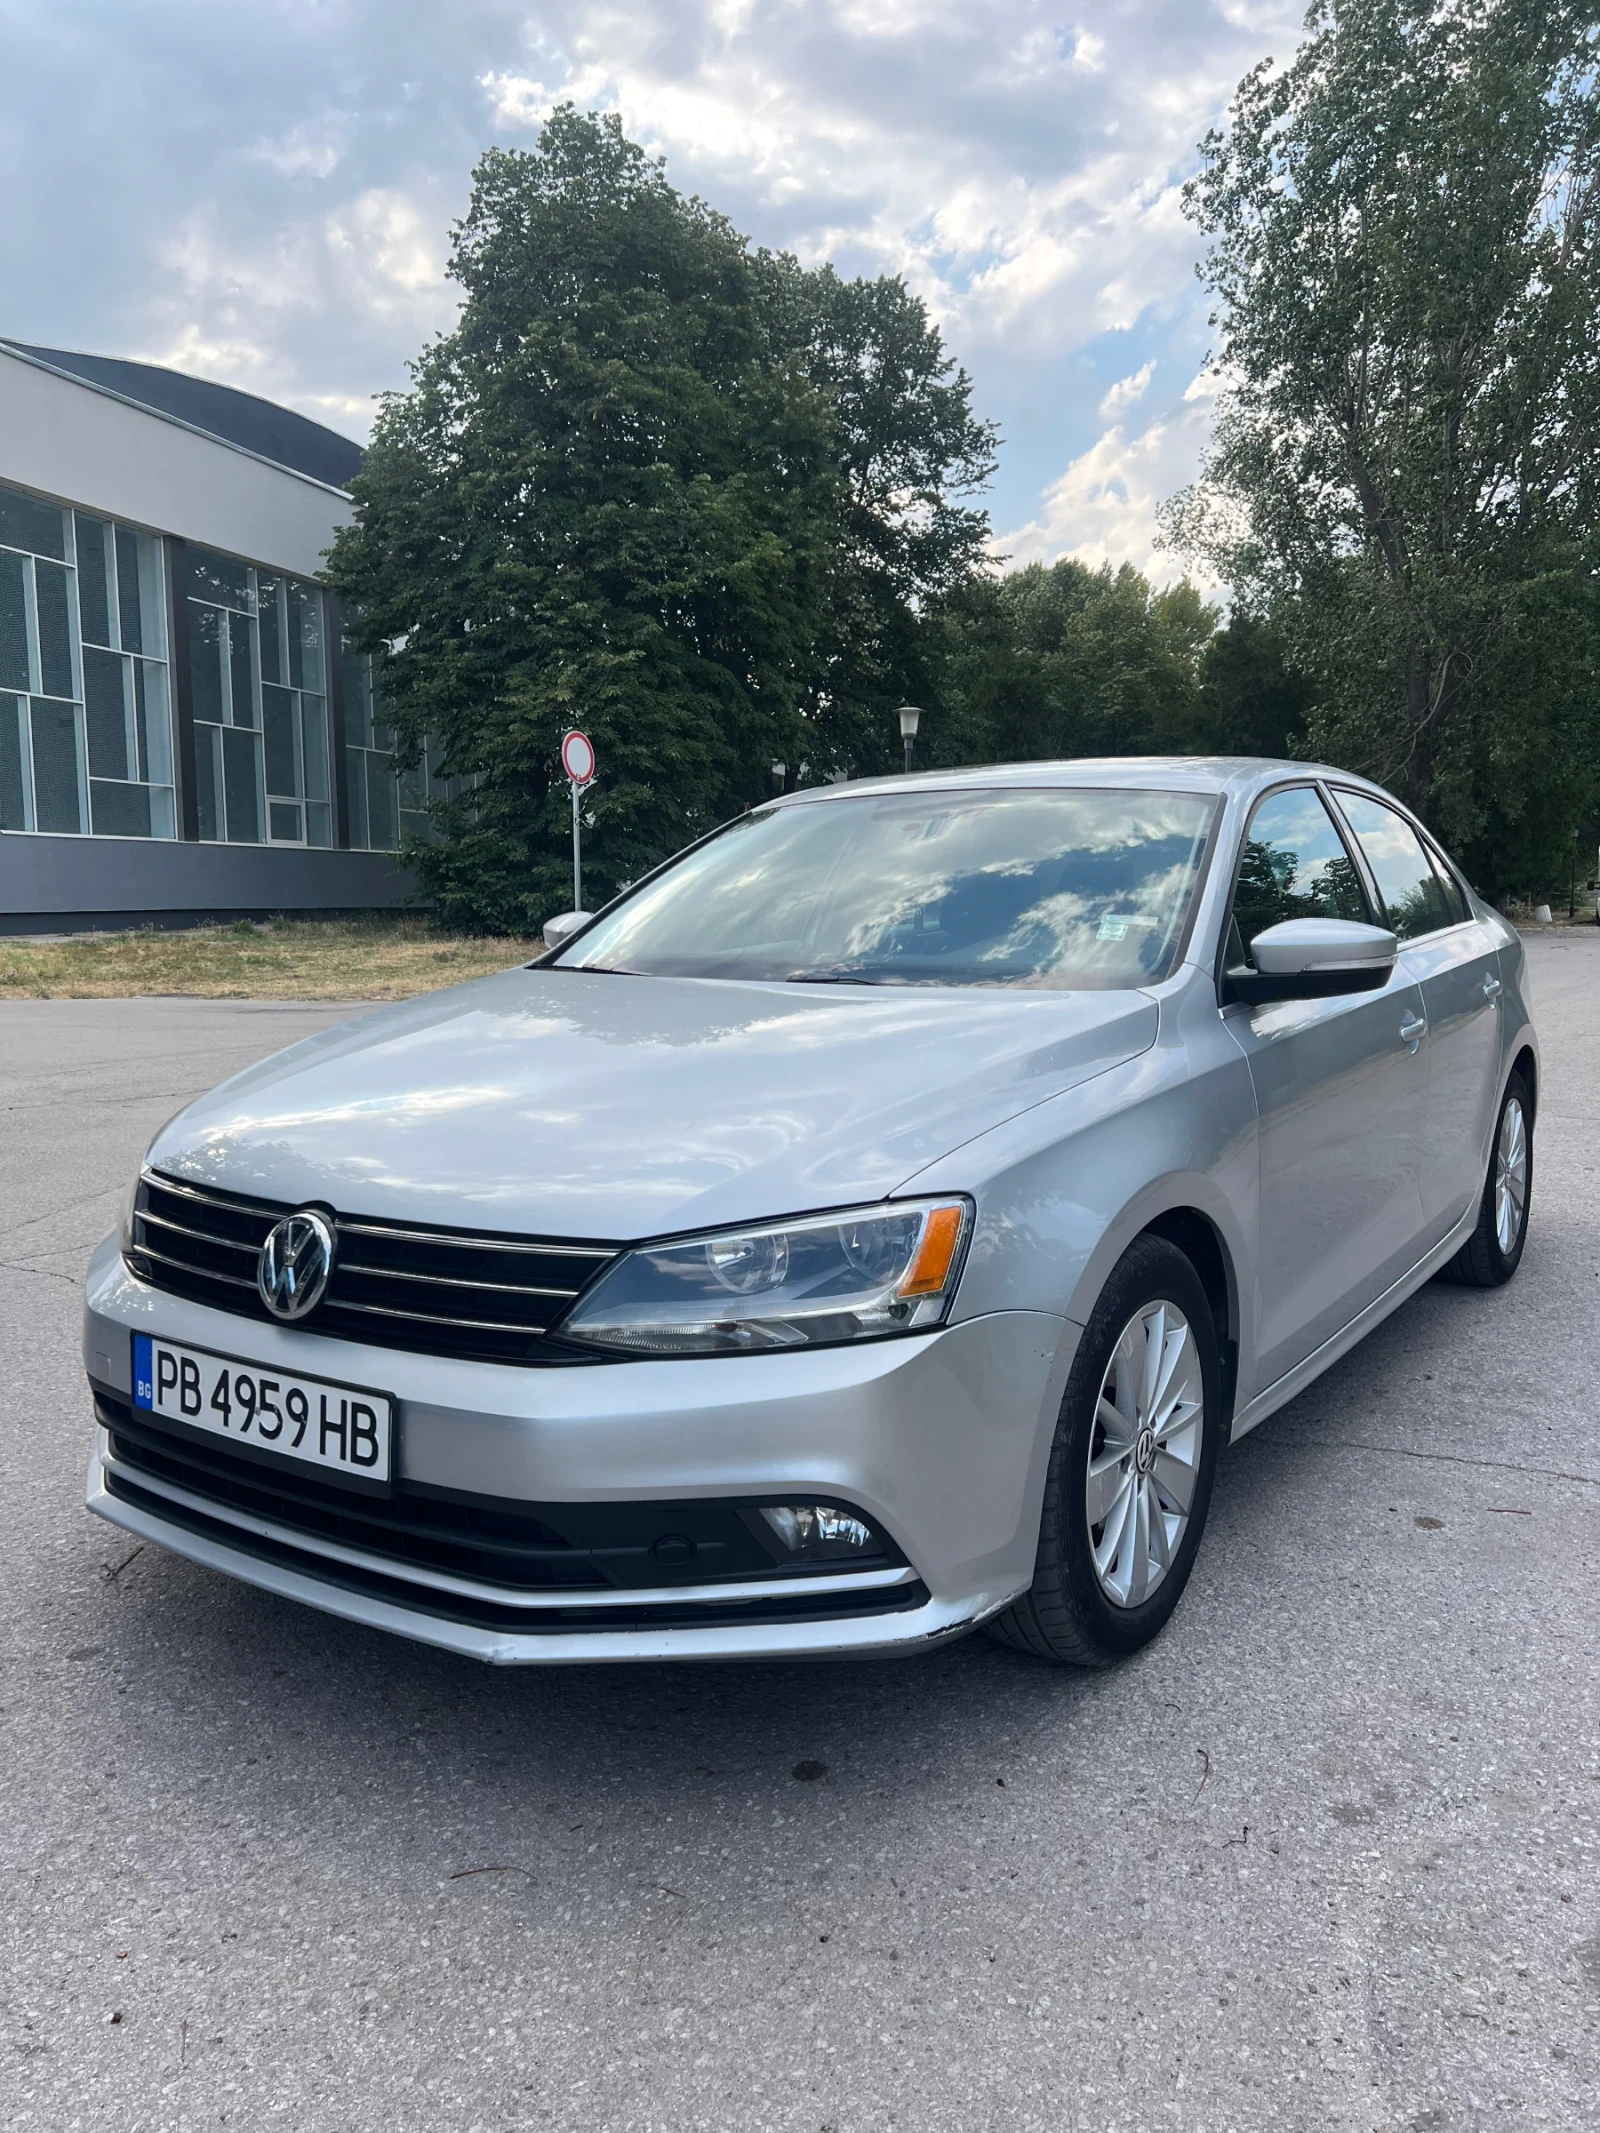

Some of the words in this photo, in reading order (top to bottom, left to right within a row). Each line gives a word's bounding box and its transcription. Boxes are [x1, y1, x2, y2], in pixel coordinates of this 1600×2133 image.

[260, 1212, 332, 1319] VW
[137, 1379, 152, 1399] BG
[157, 1349, 203, 1417] PB
[210, 1368, 309, 1449] 4959
[319, 1393, 380, 1468] HB
